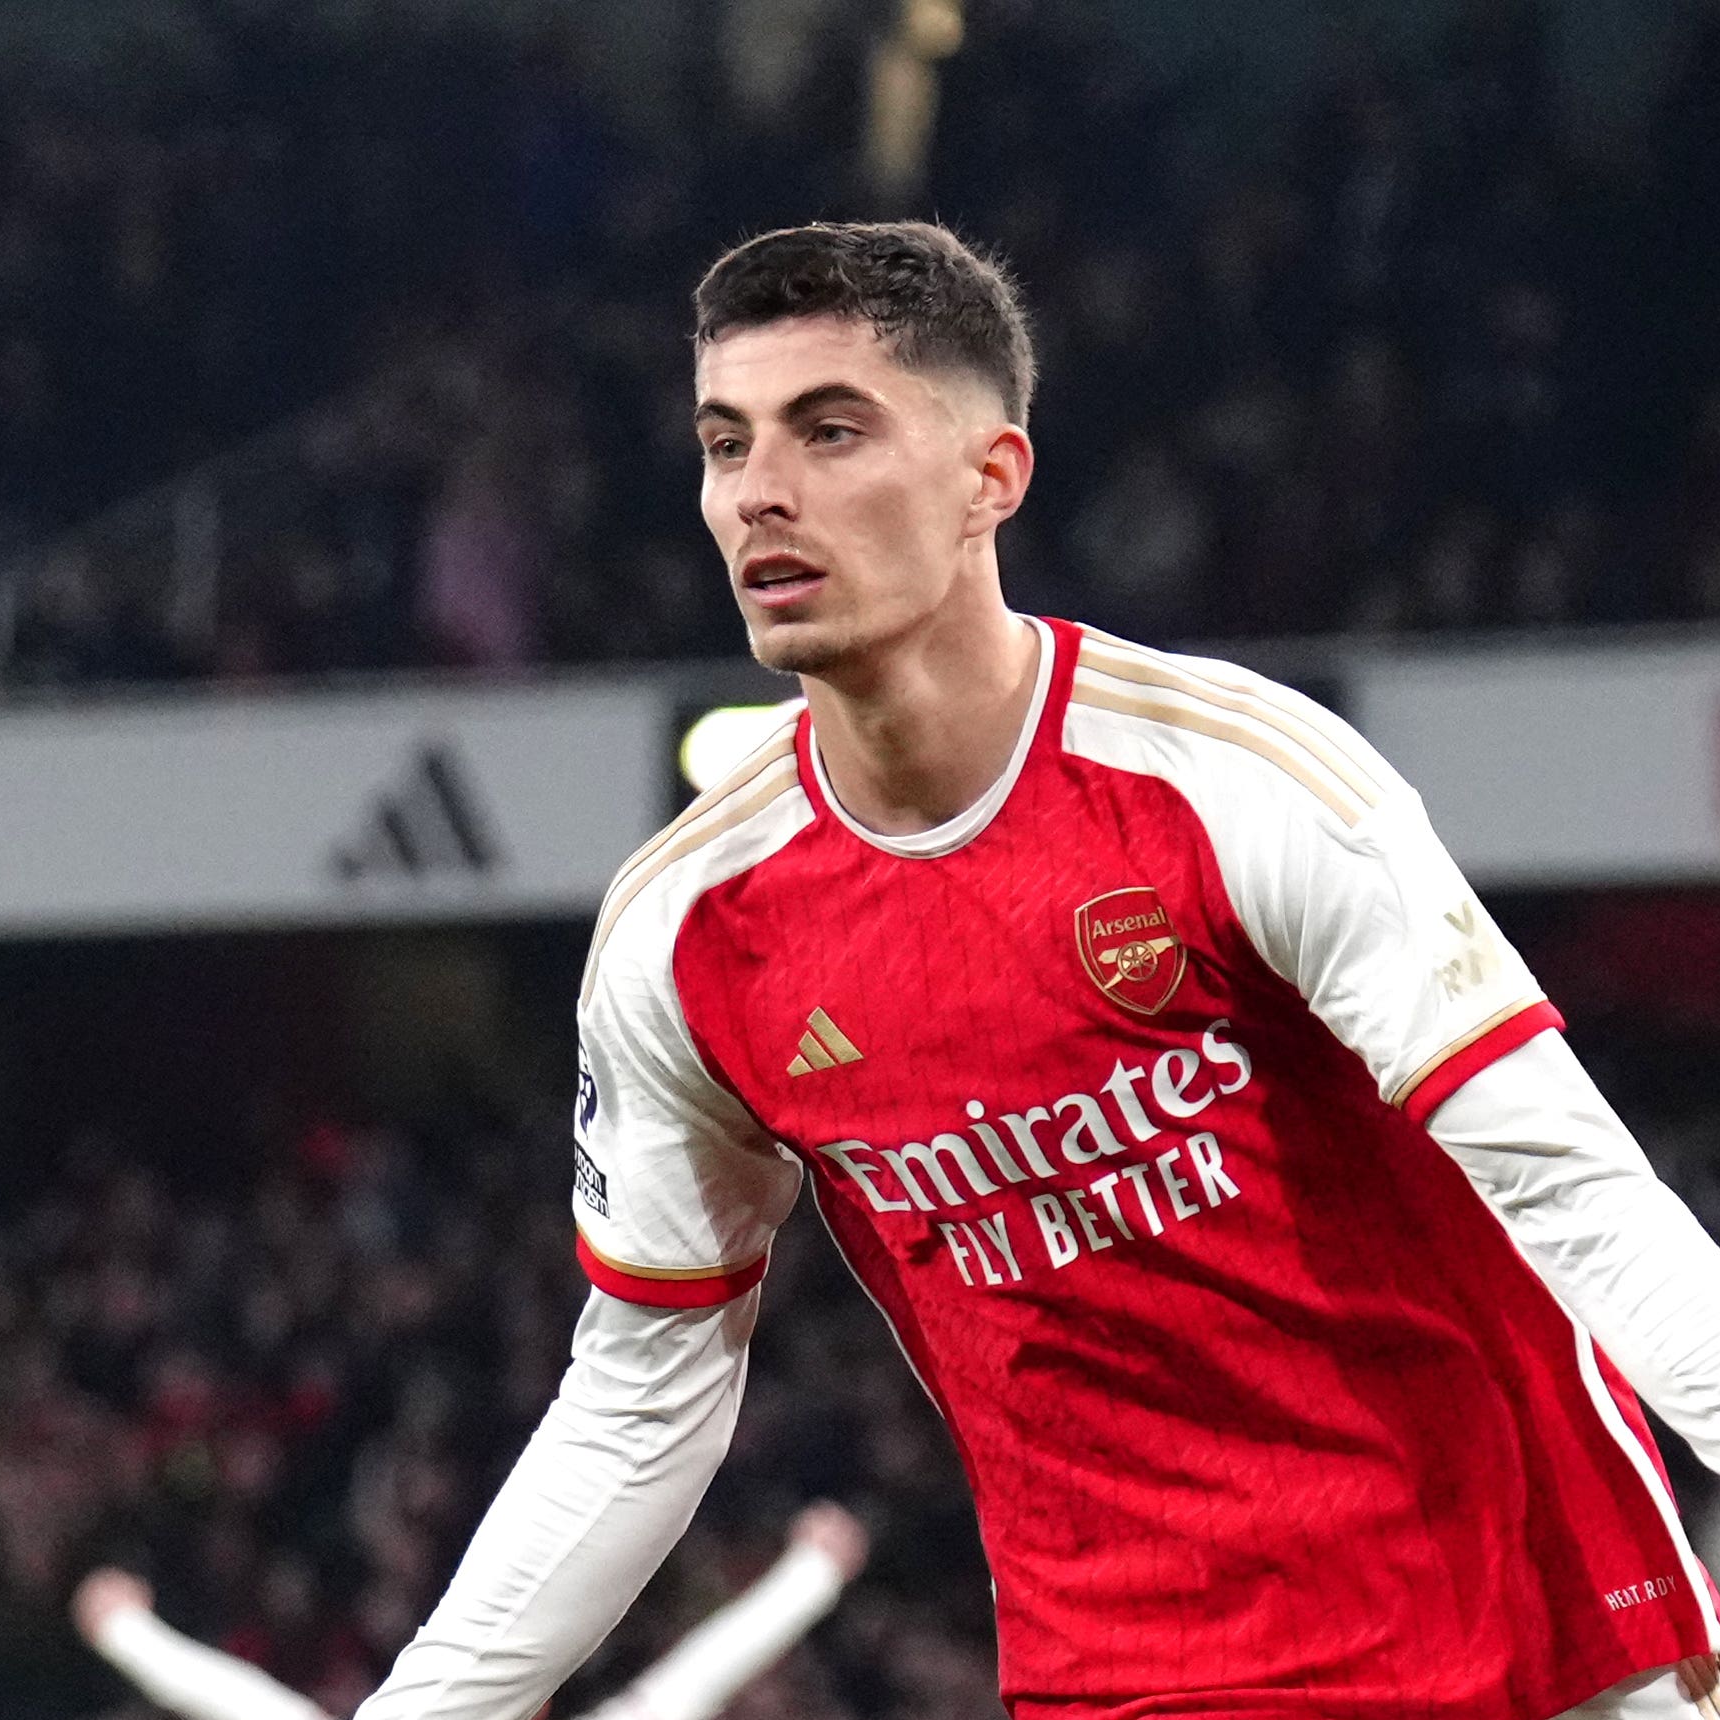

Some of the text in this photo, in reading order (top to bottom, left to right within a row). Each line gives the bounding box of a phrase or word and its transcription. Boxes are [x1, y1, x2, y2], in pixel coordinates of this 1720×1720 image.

[1092, 906, 1166, 939] Arsenal
[815, 1018, 1253, 1213] Emirates
[938, 1131, 1241, 1286] FLY BETTER
[1604, 1575, 1677, 1611] HEAT.RDY
